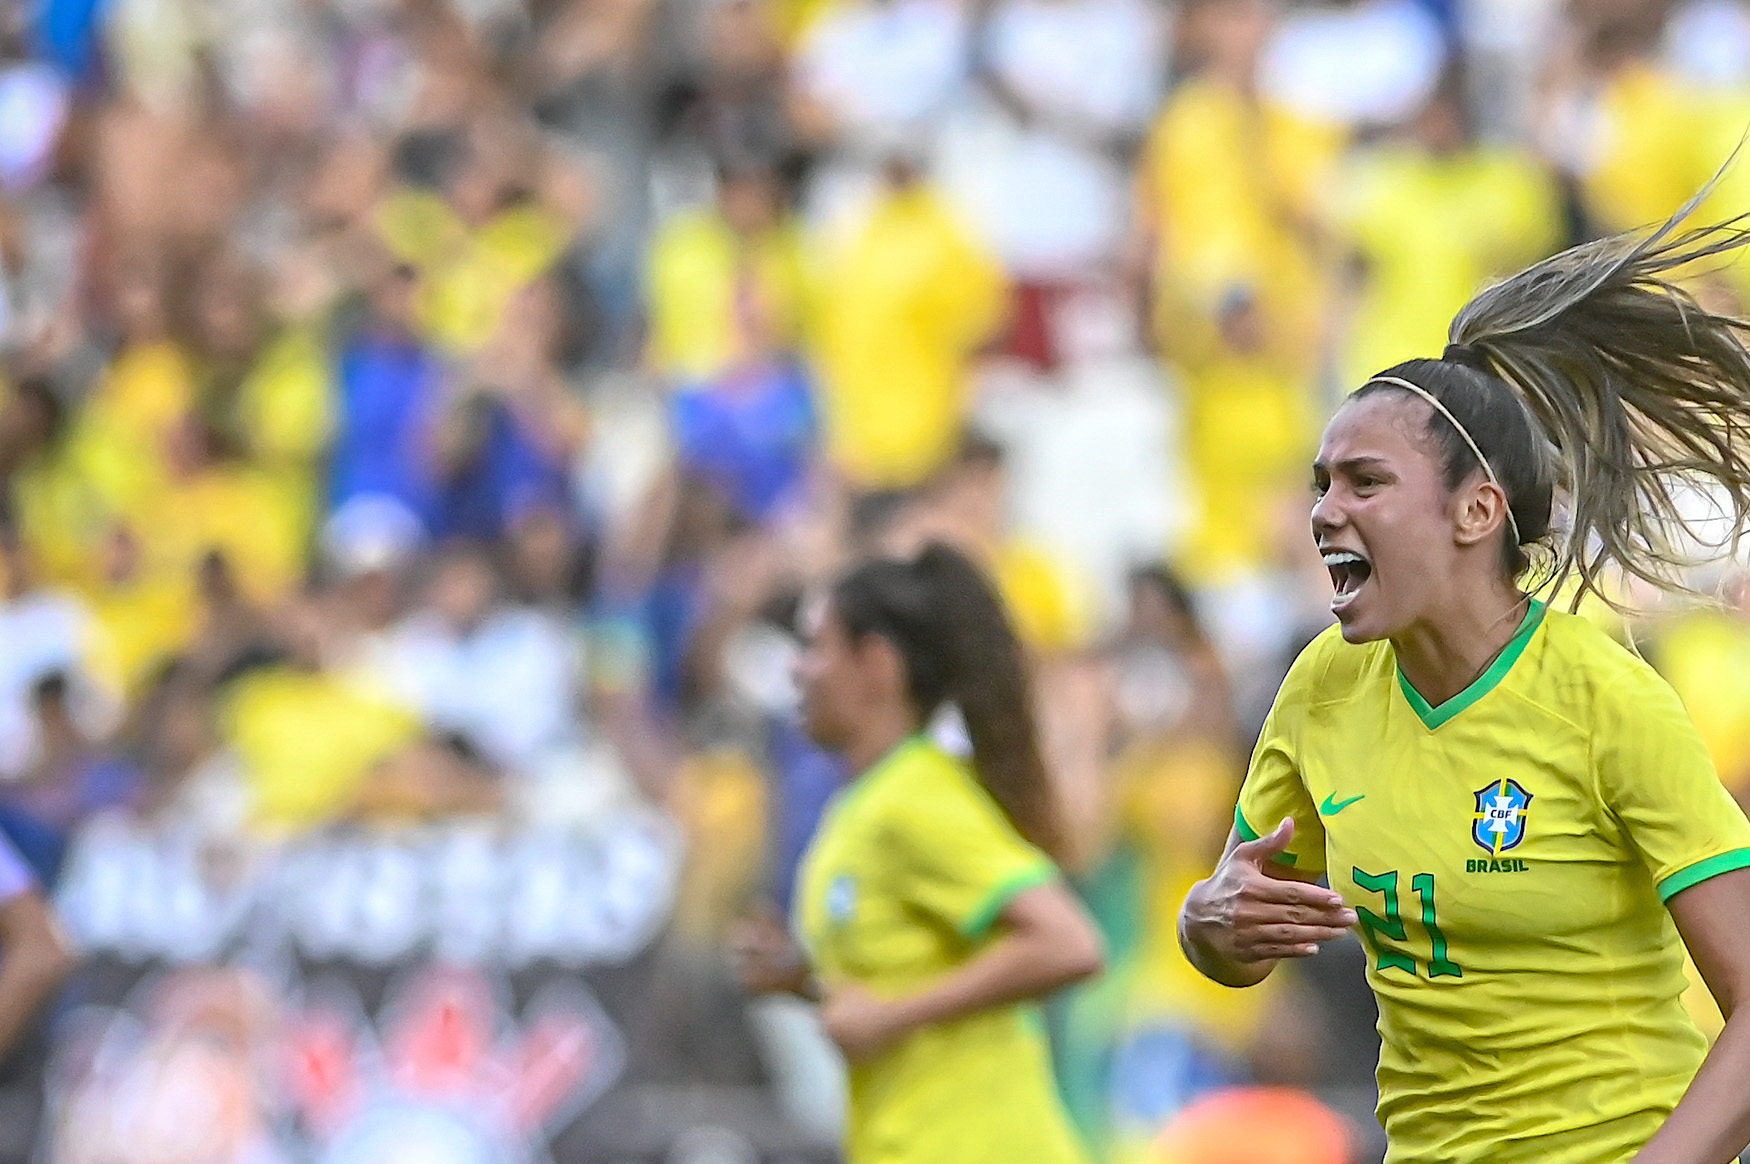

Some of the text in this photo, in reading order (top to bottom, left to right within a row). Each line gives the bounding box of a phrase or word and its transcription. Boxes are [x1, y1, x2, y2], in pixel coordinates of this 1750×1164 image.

[1490, 809, 1512, 819] CBF
[1466, 859, 1529, 873] BRASIL
[1352, 865, 1463, 978] 21
